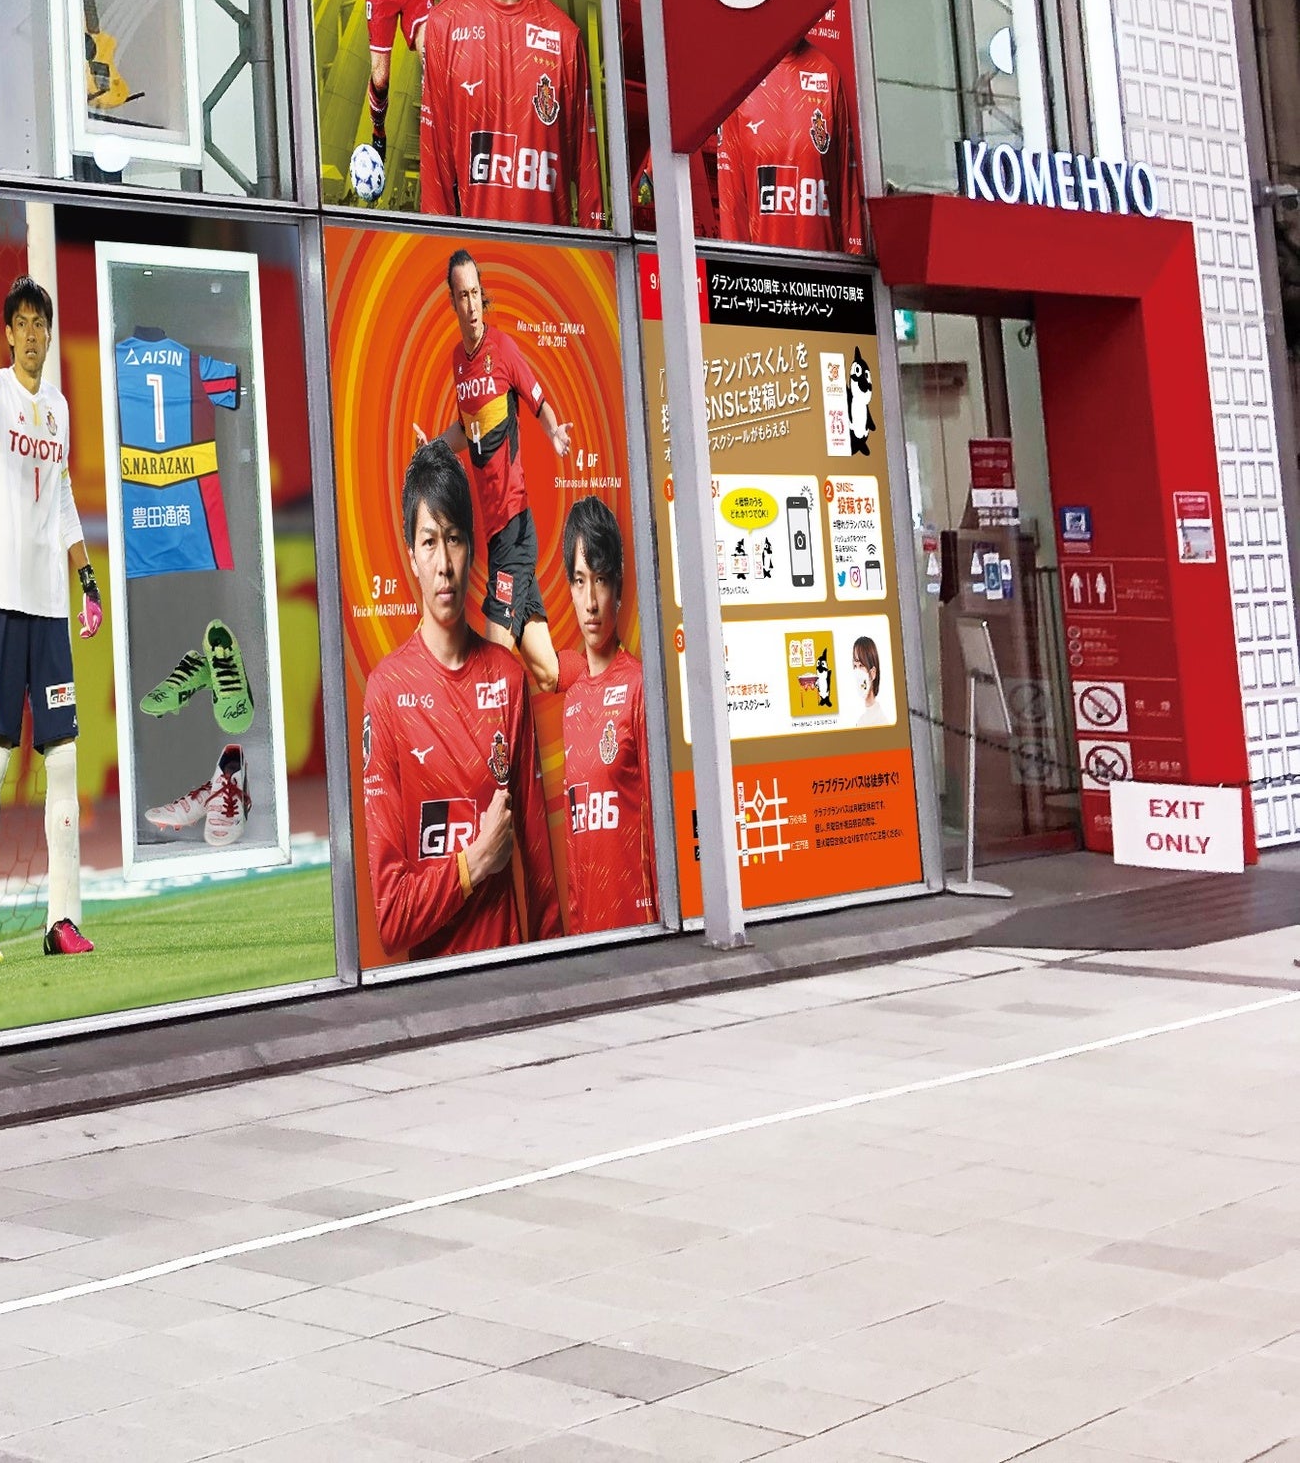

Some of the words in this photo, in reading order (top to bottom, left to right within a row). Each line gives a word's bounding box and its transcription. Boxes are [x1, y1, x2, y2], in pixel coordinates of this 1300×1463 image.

[472, 152, 513, 184] GR
[517, 148, 558, 192] 86
[956, 139, 1159, 217] KOMEHYO
[141, 350, 183, 367] AISIN
[146, 374, 165, 443] 1
[9, 429, 63, 463] TOYOTA
[122, 456, 195, 476] S.NARAZAKI
[576, 449, 584, 471] 4
[587, 453, 598, 468] DF
[132, 504, 191, 528] 豊田通商
[371, 575, 381, 599] 3
[384, 580, 398, 595] DF
[588, 791, 620, 831] 86
[1149, 798, 1206, 821] EXIT
[1145, 832, 1211, 855] ONLY
